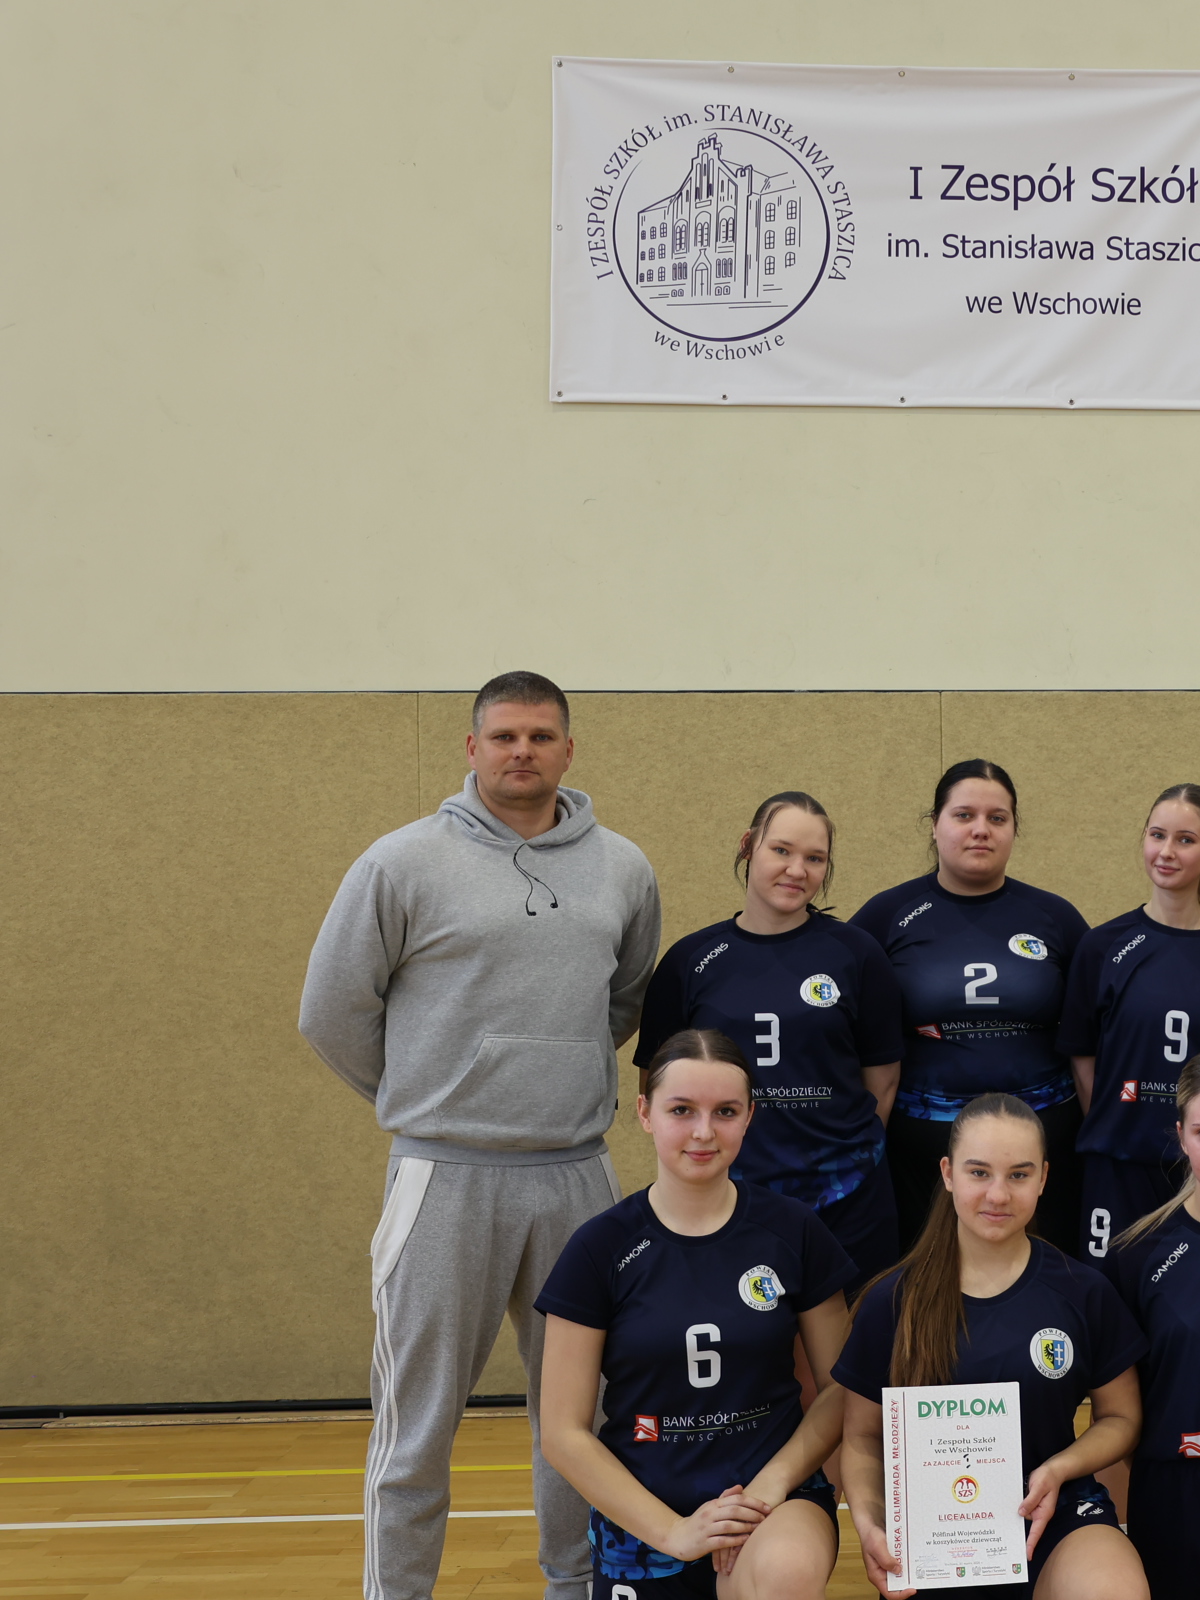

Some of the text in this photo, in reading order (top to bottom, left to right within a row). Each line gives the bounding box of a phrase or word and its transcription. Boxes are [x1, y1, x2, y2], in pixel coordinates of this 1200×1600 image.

[586, 104, 855, 282] I ZESPÓŁ SZKÓŁ im. STANISŁAWA STASZICA
[909, 162, 1199, 211] I Zespół Szkół
[887, 233, 930, 258] im.
[942, 233, 1095, 261] Stanisława
[965, 291, 1142, 316] we Wschowie
[653, 330, 786, 361] we Wschowie
[898, 901, 933, 928] DAMONS
[694, 942, 729, 974] DAMONS
[1112, 933, 1146, 964] DAMONS
[963, 962, 1000, 1005] 2
[941, 1021, 974, 1031] BANK
[1164, 1010, 1190, 1063] 9
[754, 1012, 780, 1067] 3
[766, 1085, 833, 1097] SPÓŁDZIELCZY
[1140, 1081, 1167, 1092] BANK
[760, 1101, 819, 1109] WSCHOWIE
[1140, 1095, 1154, 1103] WE
[1088, 1207, 1111, 1258] 9
[745, 1266, 775, 1277] POWIAT
[1151, 1241, 1189, 1283] DAMONS
[1038, 1328, 1067, 1339] POWIAT
[685, 1323, 721, 1389] 6
[917, 1397, 1007, 1418] DYPLOM
[662, 1416, 695, 1427] BANK
[662, 1420, 758, 1443] WE WSCOWIE
[891, 1399, 900, 1459] MŁODZIEŻY
[937, 1437, 971, 1447] Zespołu
[972, 1436, 996, 1444] Szkół
[948, 1446, 993, 1454] Wschowie
[933, 1459, 962, 1467] ZAJĘCIE
[892, 1463, 901, 1523] OLIMPIADA
[957, 1489, 974, 1498] SZS
[938, 1511, 995, 1521] LICEALIADA
[957, 1528, 996, 1538] Wojewódzki
